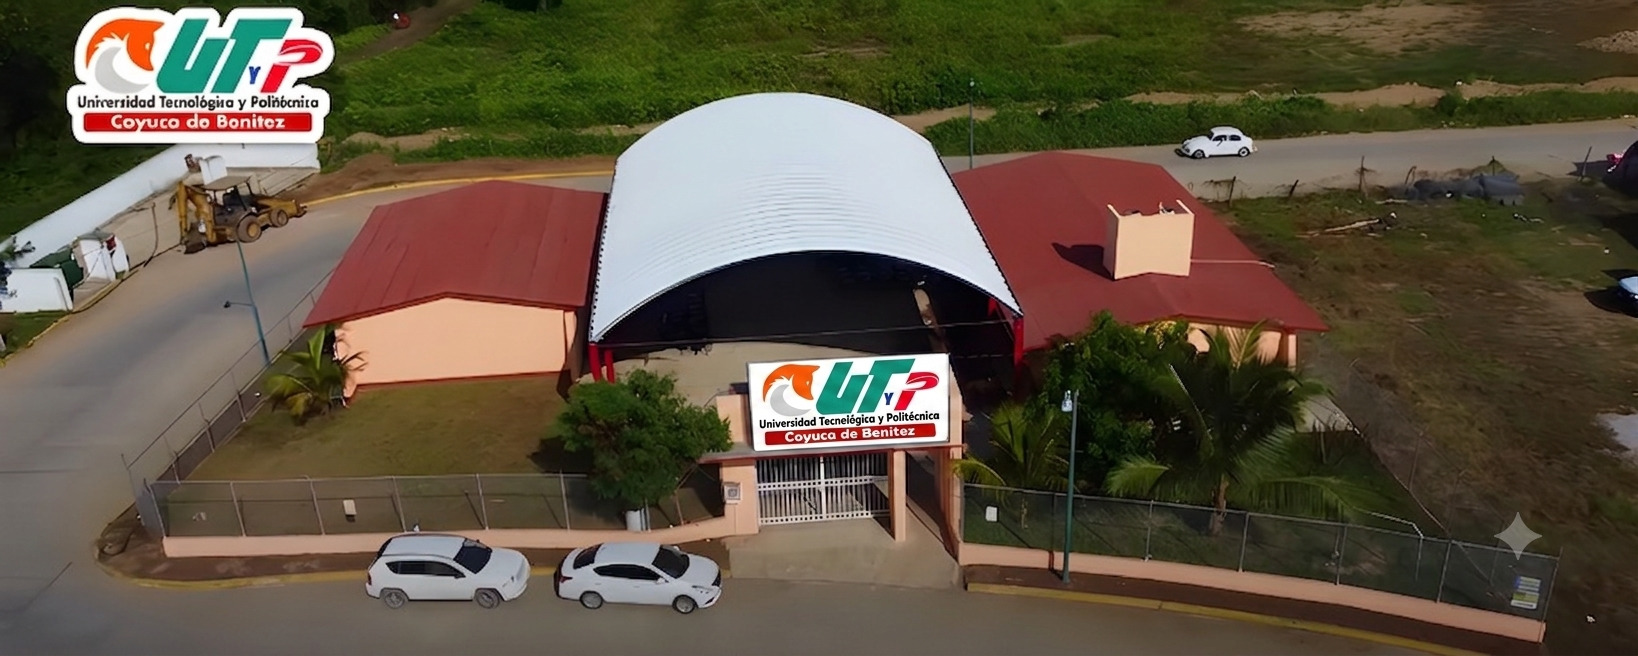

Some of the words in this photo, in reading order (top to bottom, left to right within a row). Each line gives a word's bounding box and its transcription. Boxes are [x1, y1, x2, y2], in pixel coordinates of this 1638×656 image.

[759, 417, 817, 429] Universidad
[878, 415, 884, 425] y
[886, 411, 940, 423] Politécnica
[784, 431, 837, 444] Coyuca
[840, 429, 858, 439] de
[861, 426, 916, 439] Benitez
